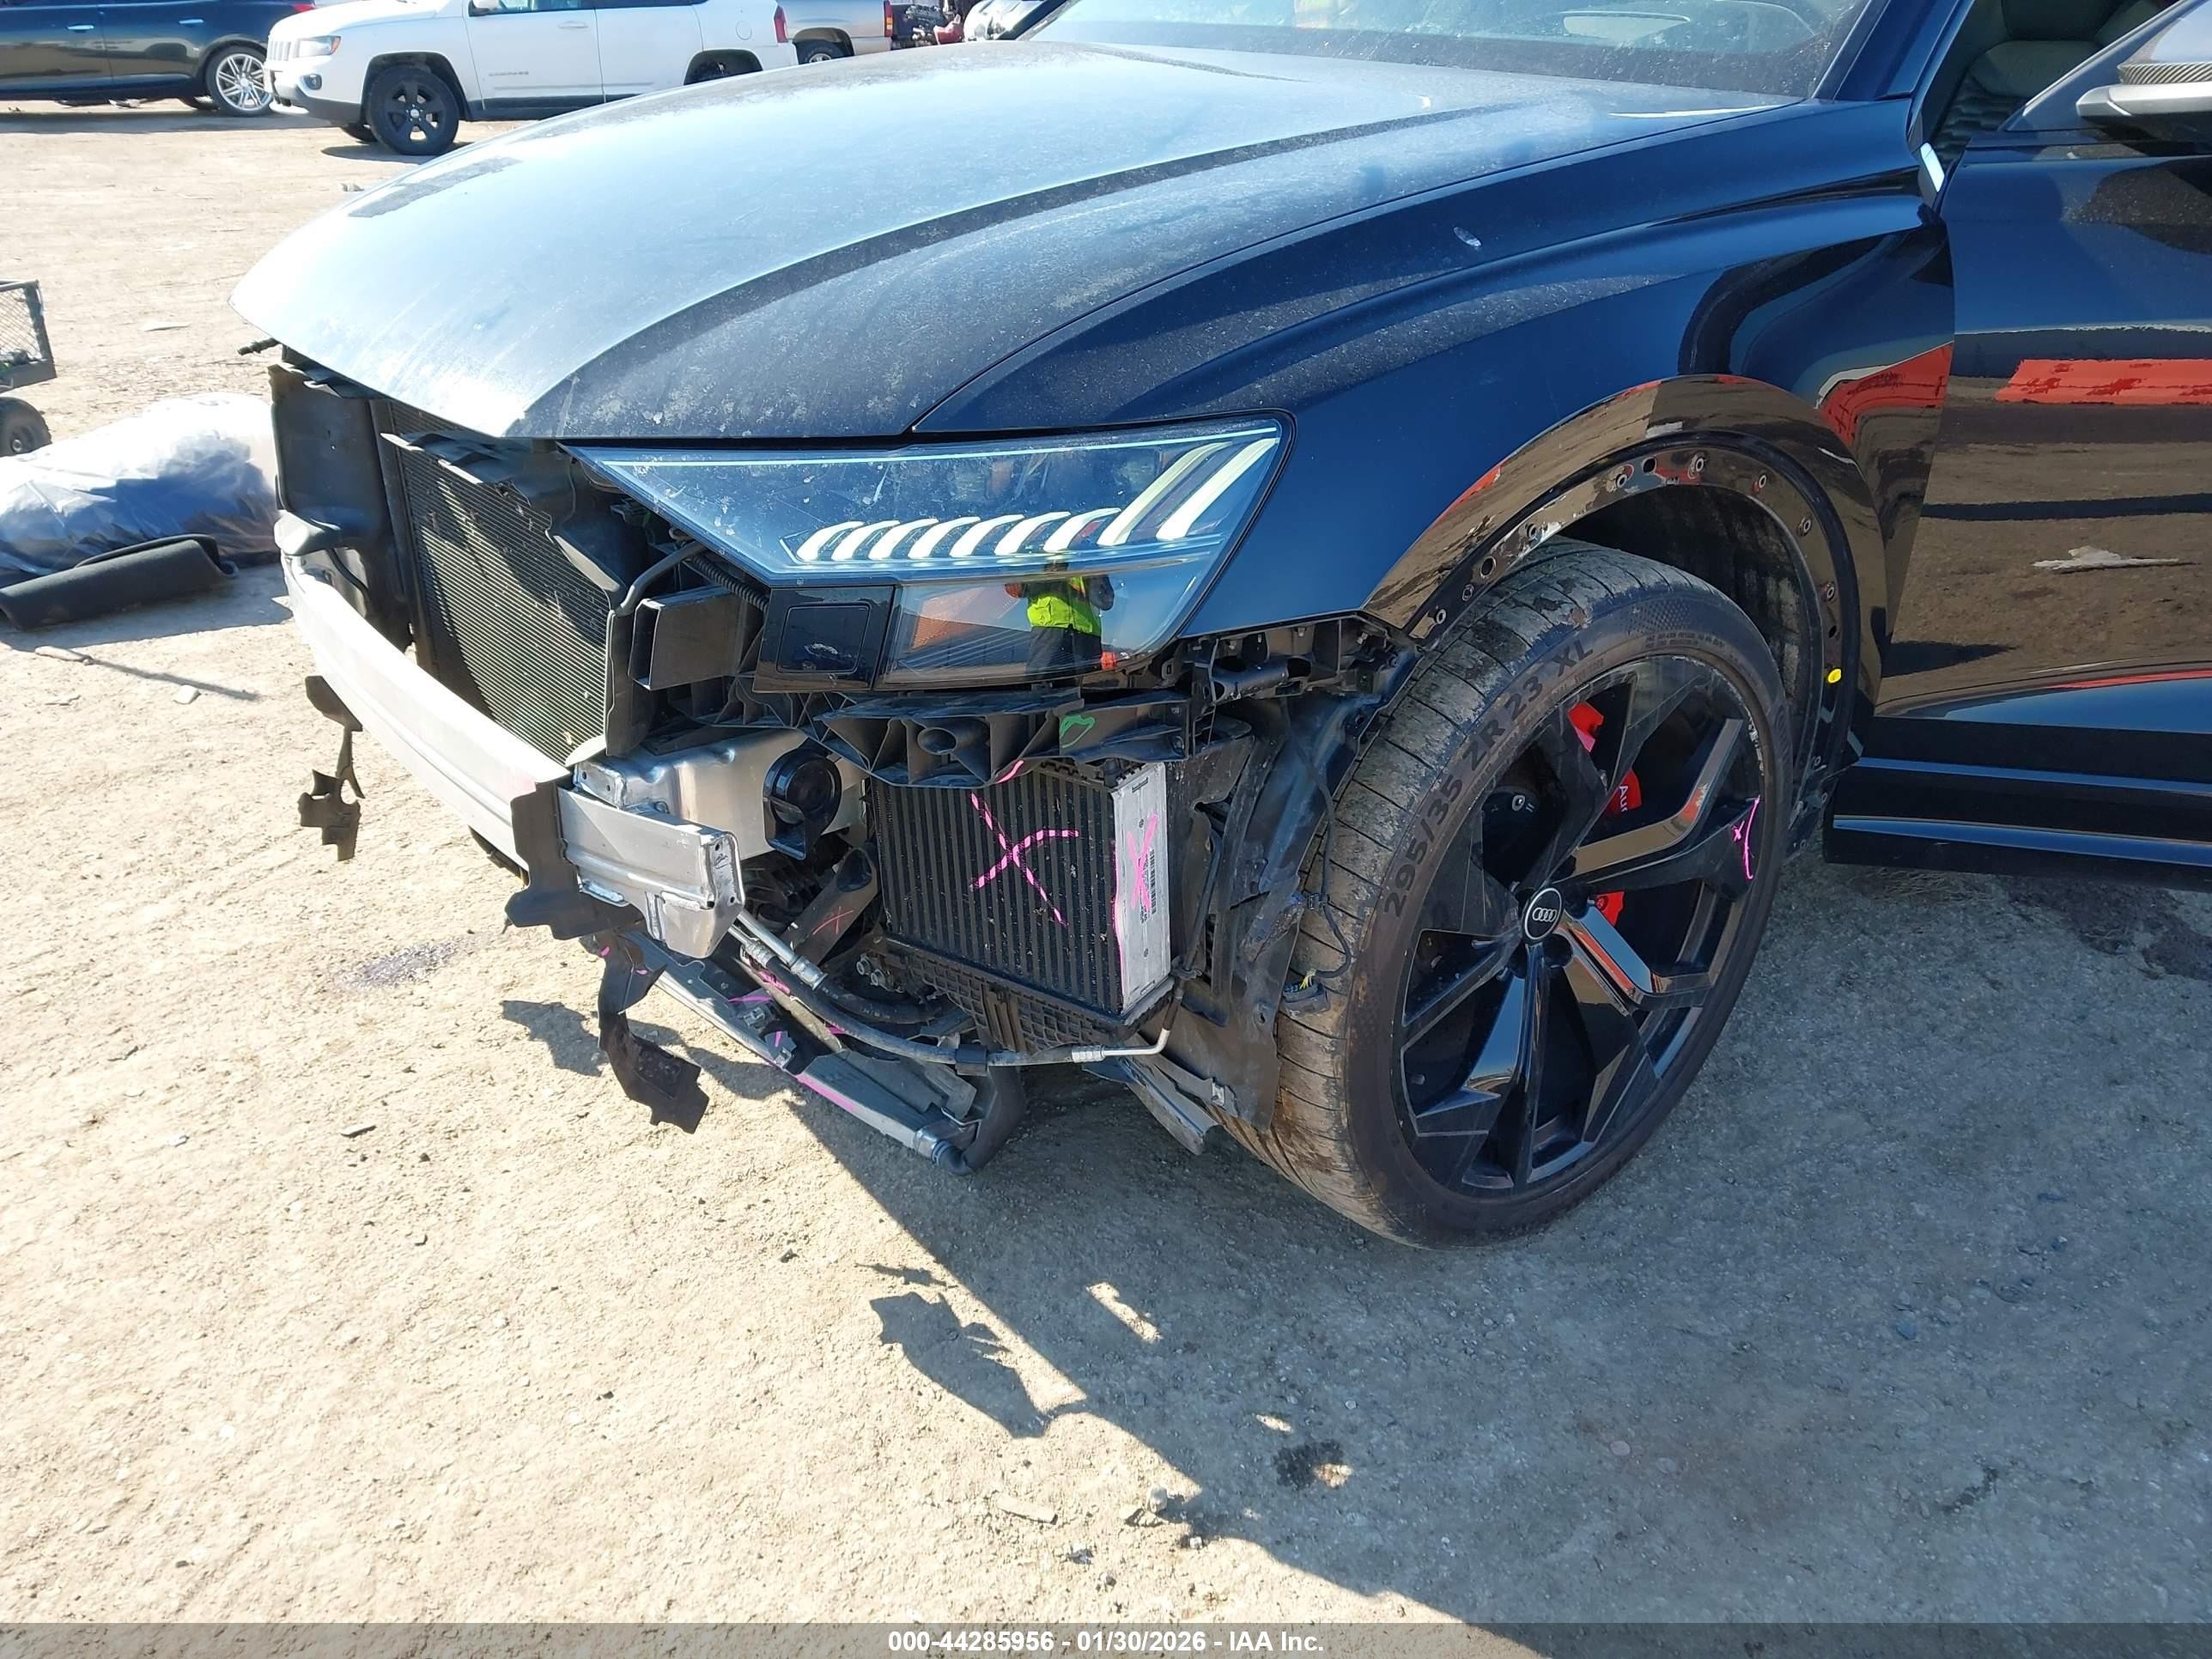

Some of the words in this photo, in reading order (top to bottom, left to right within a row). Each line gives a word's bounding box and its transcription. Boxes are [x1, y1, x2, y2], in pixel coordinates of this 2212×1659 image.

[1384, 770, 1463, 918] 295/35
[1462, 720, 1505, 771] ZR
[1504, 674, 1544, 722] 23
[1553, 638, 1594, 678] XL
